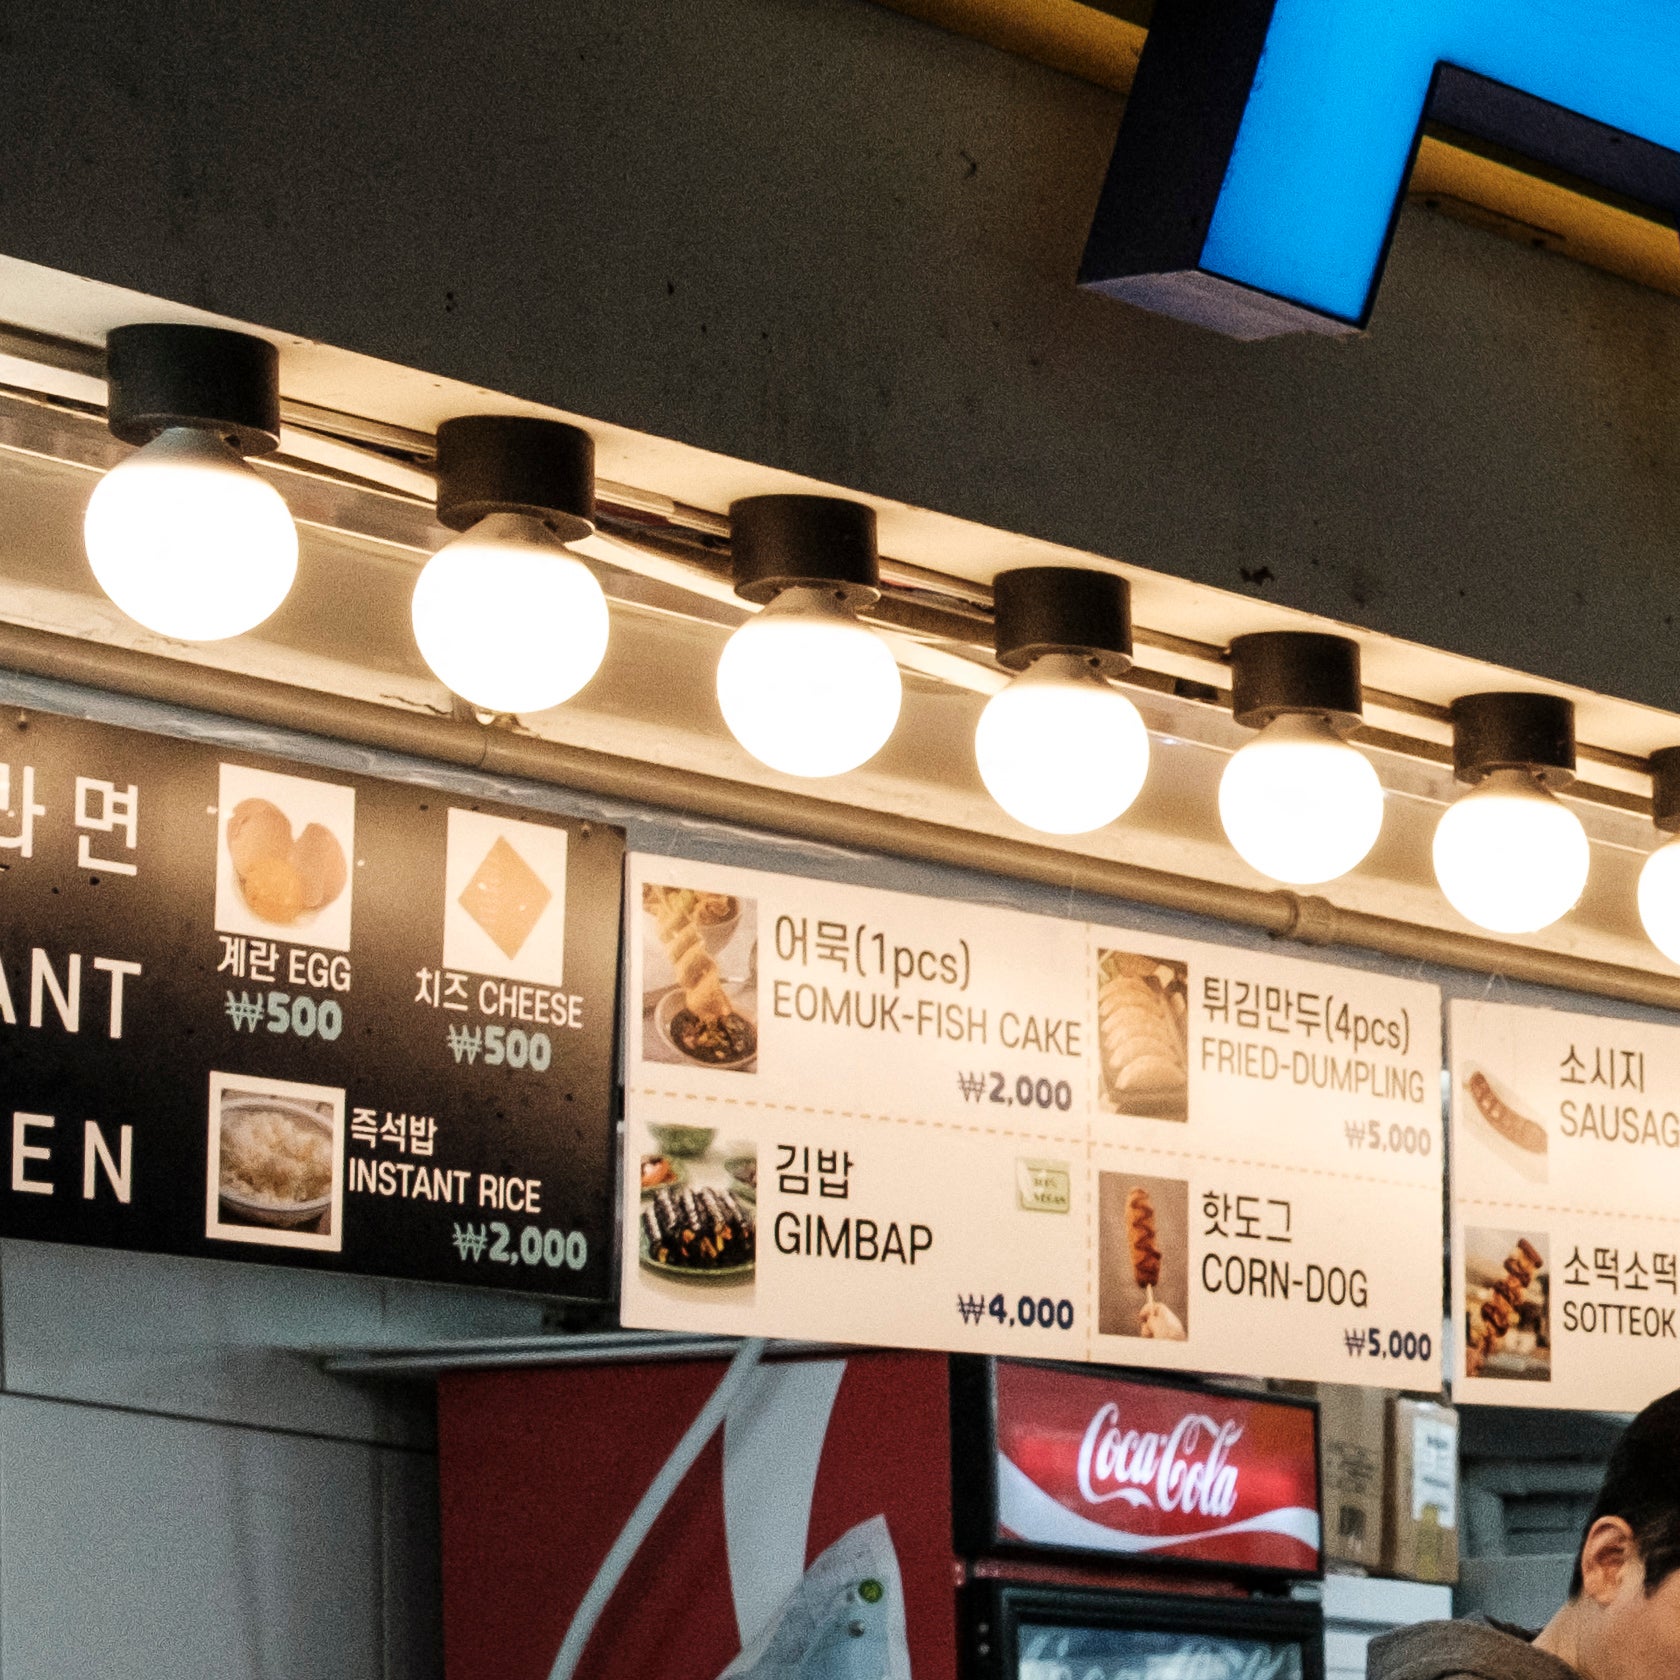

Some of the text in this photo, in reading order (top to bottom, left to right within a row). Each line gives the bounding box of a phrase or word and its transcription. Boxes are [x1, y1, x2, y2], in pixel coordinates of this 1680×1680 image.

[217, 935, 352, 993] 계란 EGG
[773, 914, 972, 992] 어묵(1pcs)
[224, 989, 343, 1042] ₩500
[414, 967, 585, 1030] 치즈 CHEESE
[772, 980, 1083, 1059] EOMUK-FISH CAKE
[1202, 974, 1411, 1057] 튀김만두(4pcs)
[447, 1023, 552, 1073] ₩500
[1201, 1035, 1425, 1107] FRIED-DUMPLING
[1559, 1043, 1646, 1094] 소시지
[957, 1068, 1073, 1114] ₩2,000
[350, 1106, 438, 1156] 즉석밥
[1343, 1118, 1432, 1158] ₩5,000
[348, 1156, 542, 1215] INSTANT RICE
[774, 1144, 854, 1201] 김밥
[773, 1211, 934, 1268] GIMBAP
[1202, 1191, 1294, 1245] 핫도그
[453, 1220, 588, 1271] ₩2,000
[1563, 1244, 1680, 1297] 소떡소떡
[1201, 1252, 1369, 1310] CORN-DOG
[957, 1291, 1075, 1333] ₩4,000
[1562, 1299, 1678, 1340] SOTTEOK
[1343, 1325, 1433, 1363] ₩5,000
